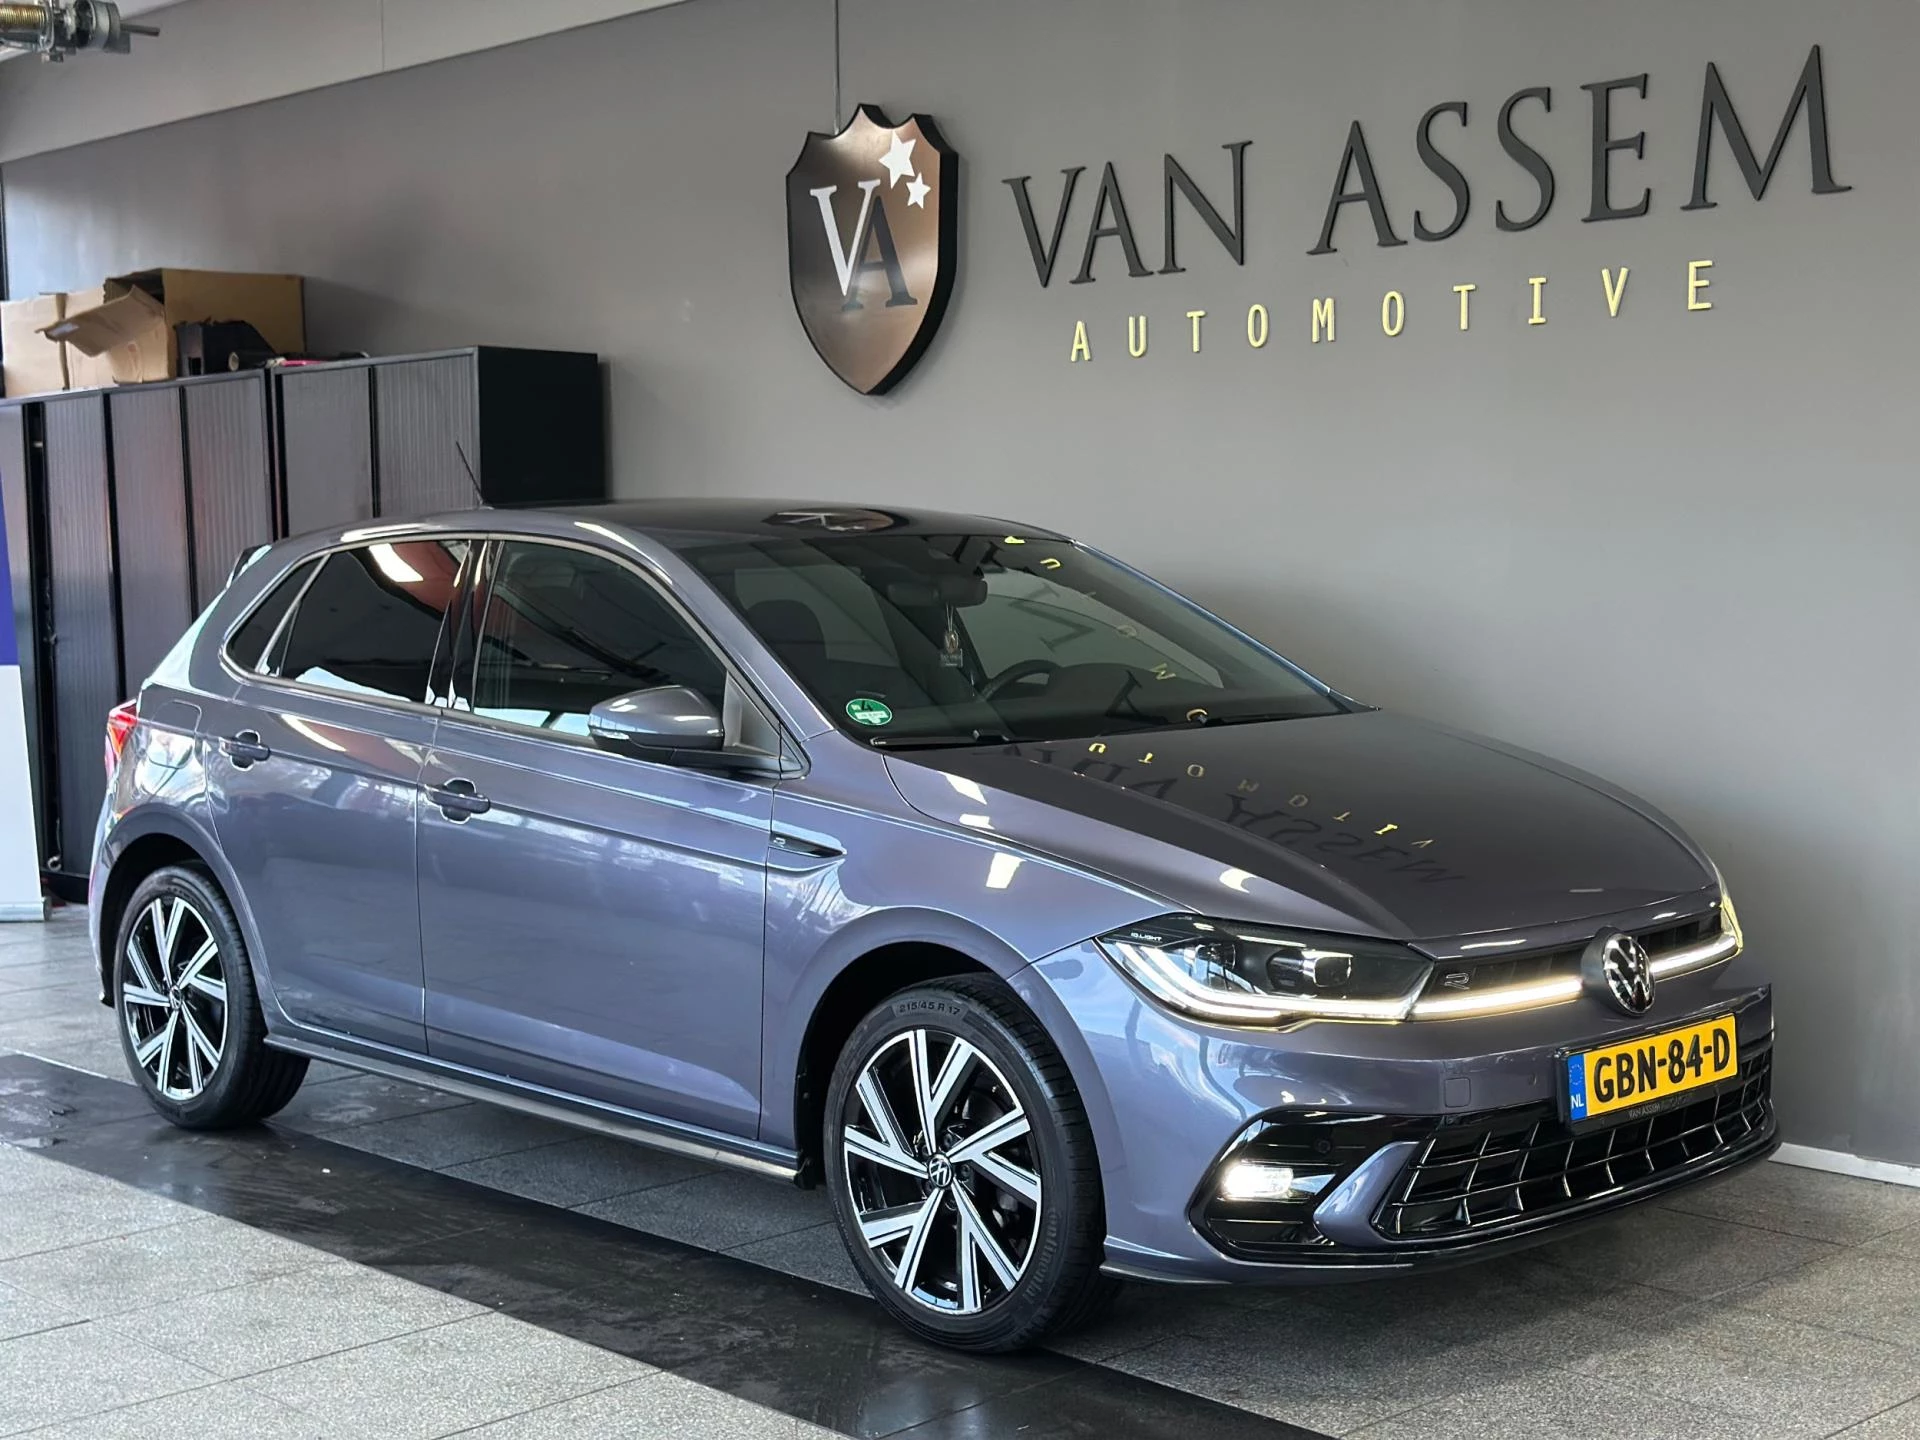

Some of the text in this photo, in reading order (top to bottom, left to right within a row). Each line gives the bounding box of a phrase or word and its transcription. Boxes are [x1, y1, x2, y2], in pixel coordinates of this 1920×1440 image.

[1002, 44, 1852, 288] VAN ASSEM
[810, 178, 918, 312] VA
[1070, 260, 1713, 362] AUTOMOTIVE
[900, 1001, 961, 1015] 215/45 R 17
[1571, 1093, 1585, 1110] NL
[1593, 1028, 1730, 1104] GBN-84-D
